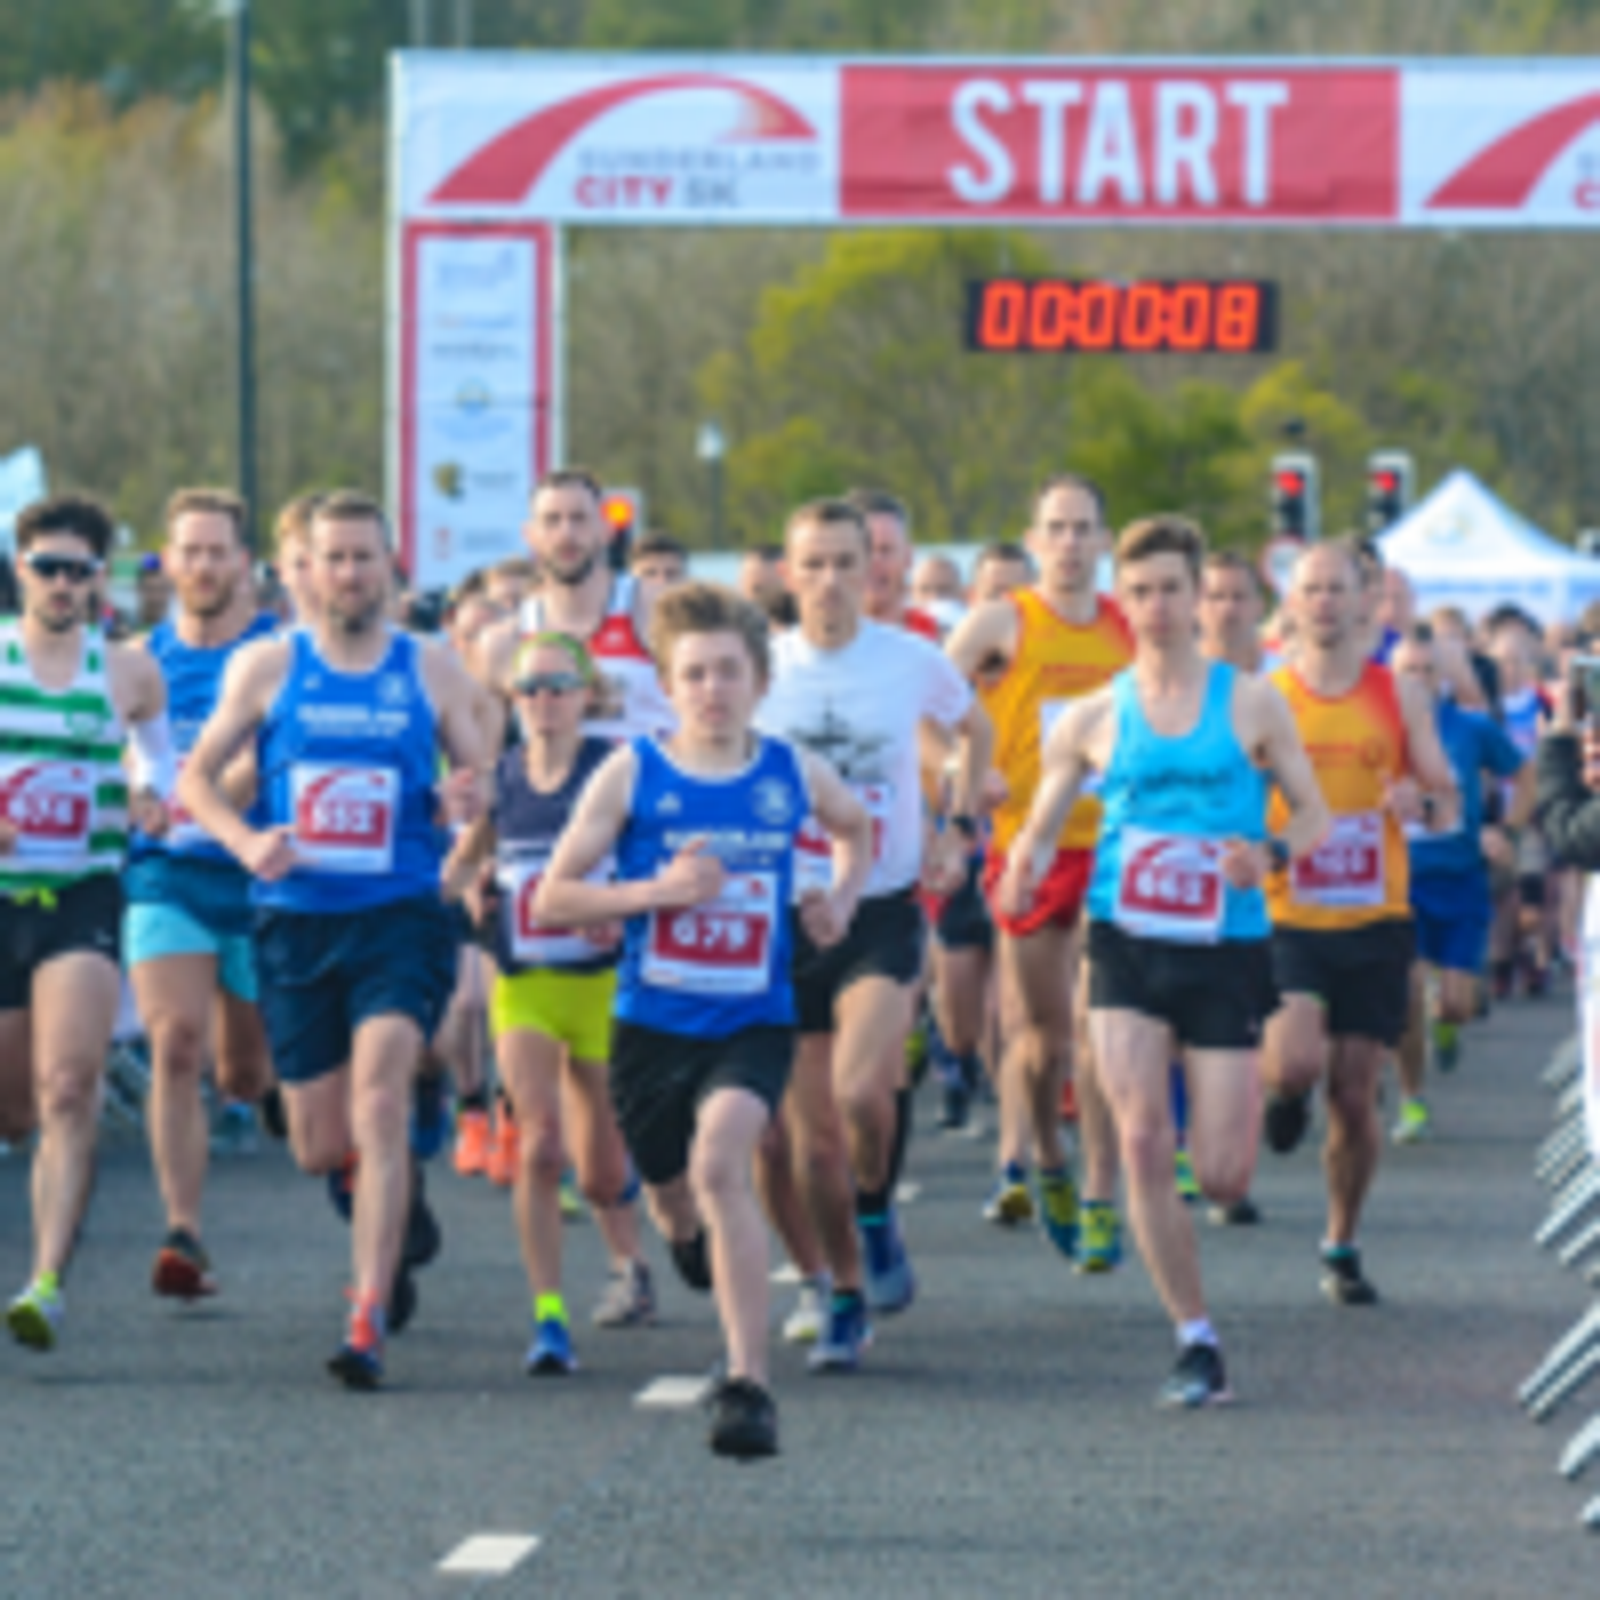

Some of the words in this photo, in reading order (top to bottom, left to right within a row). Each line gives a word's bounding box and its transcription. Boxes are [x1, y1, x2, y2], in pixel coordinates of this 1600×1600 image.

[949, 80, 1290, 205] START
[575, 177, 672, 207] CITY
[977, 281, 1260, 349] 00:00:08
